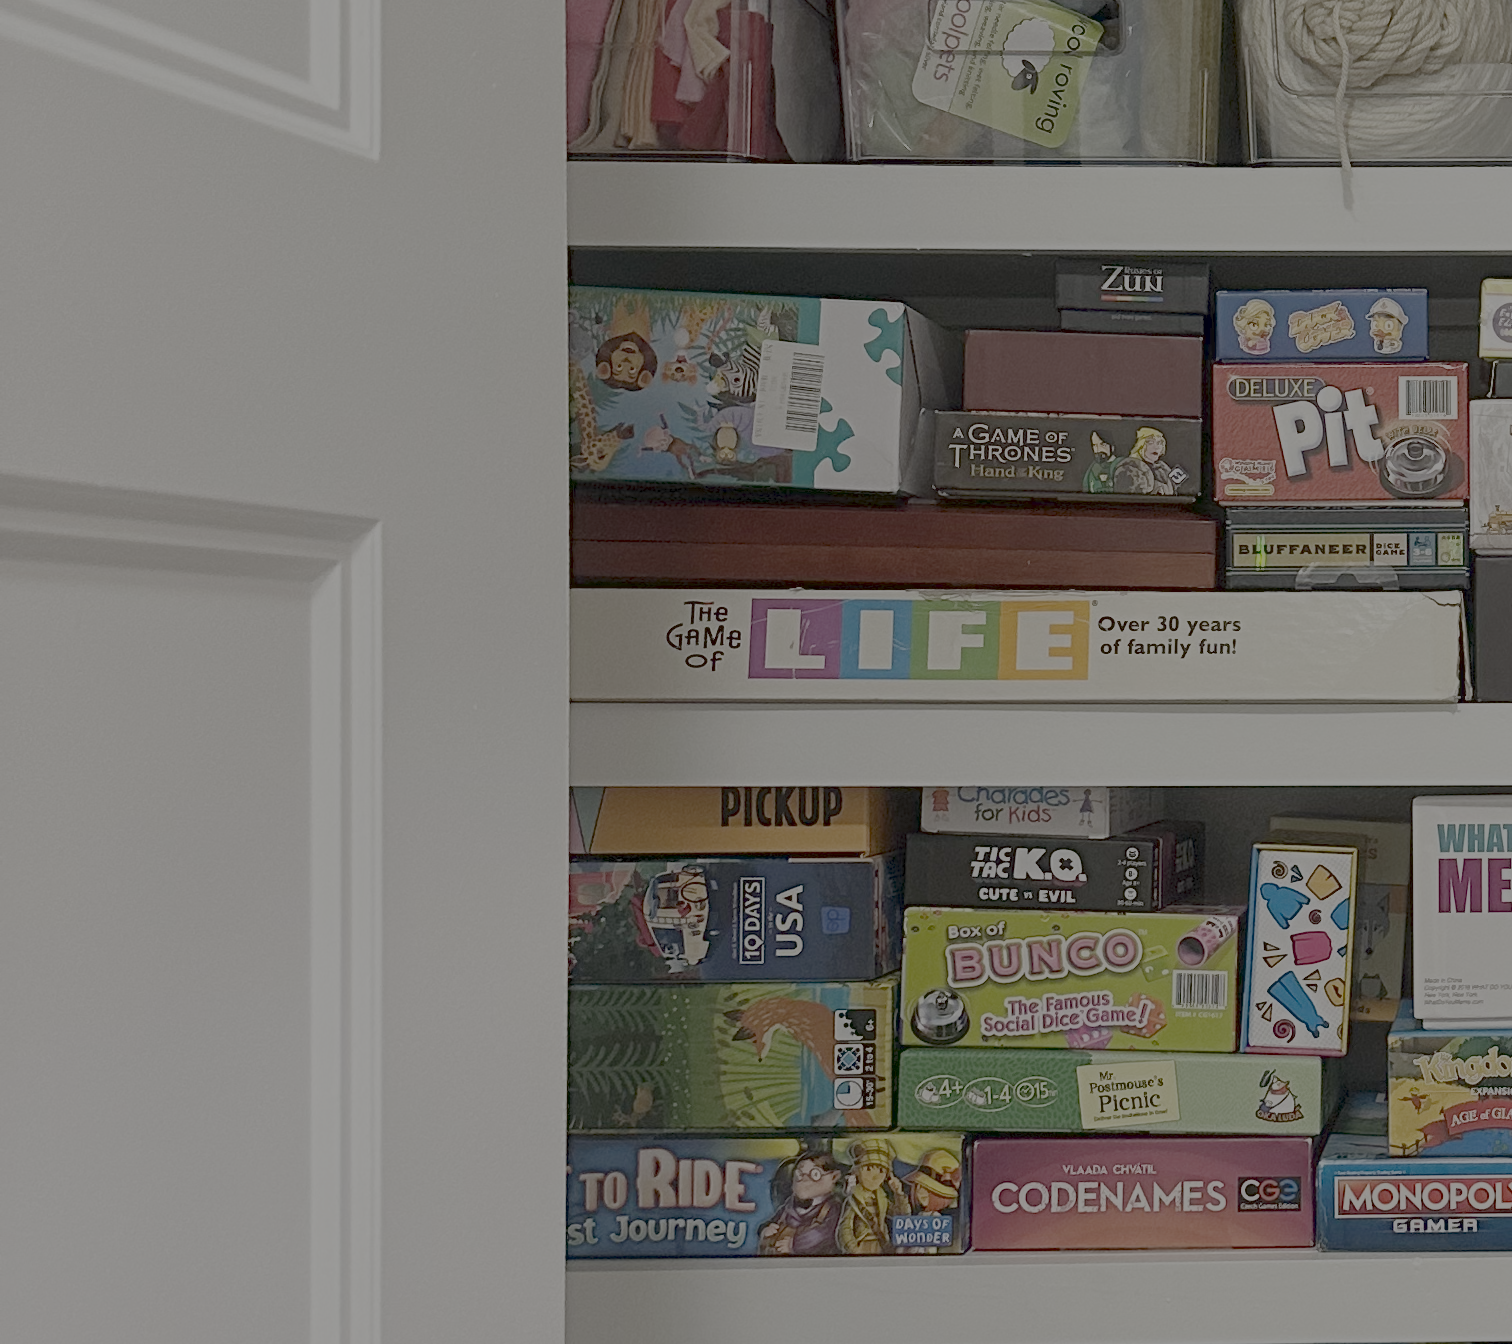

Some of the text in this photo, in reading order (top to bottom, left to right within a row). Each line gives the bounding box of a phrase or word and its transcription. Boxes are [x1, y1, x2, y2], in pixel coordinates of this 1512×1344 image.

[1034, 63, 1073, 134] roving
[1235, 379, 1316, 398] DELUXE
[952, 423, 1069, 447] A GAME OF
[948, 444, 1073, 469] THRONES
[970, 464, 1065, 481] Hand King
[1238, 543, 1368, 556] BLUFFANEER
[1098, 615, 1242, 637] Over 30 years
[764, 608, 1075, 671] LIFE
[1099, 637, 1238, 660] of family fun!
[720, 787, 843, 828] PICKUP
[974, 803, 1053, 825] for Kids
[974, 845, 1012, 862] TIC
[970, 860, 1011, 879] TAC
[978, 887, 1019, 902] CUTE
[1037, 890, 1077, 904] EVIL
[775, 884, 804, 957] USA
[948, 921, 1007, 940] Box of
[950, 931, 1140, 985] BUNCO
[1007, 992, 1112, 1017] The Famous
[983, 1001, 1149, 1034] Social Dice Game!
[1089, 1076, 1165, 1094] Postmouse's
[1098, 1092, 1162, 1113] Picnic
[1062, 1162, 1157, 1176] VLAADA CHVÁTIL
[578, 1148, 757, 1213] TO RIDE
[991, 1181, 1227, 1214] CODENAMES
[610, 1215, 746, 1250] Journey
[894, 1218, 951, 1232] DAYS OF
